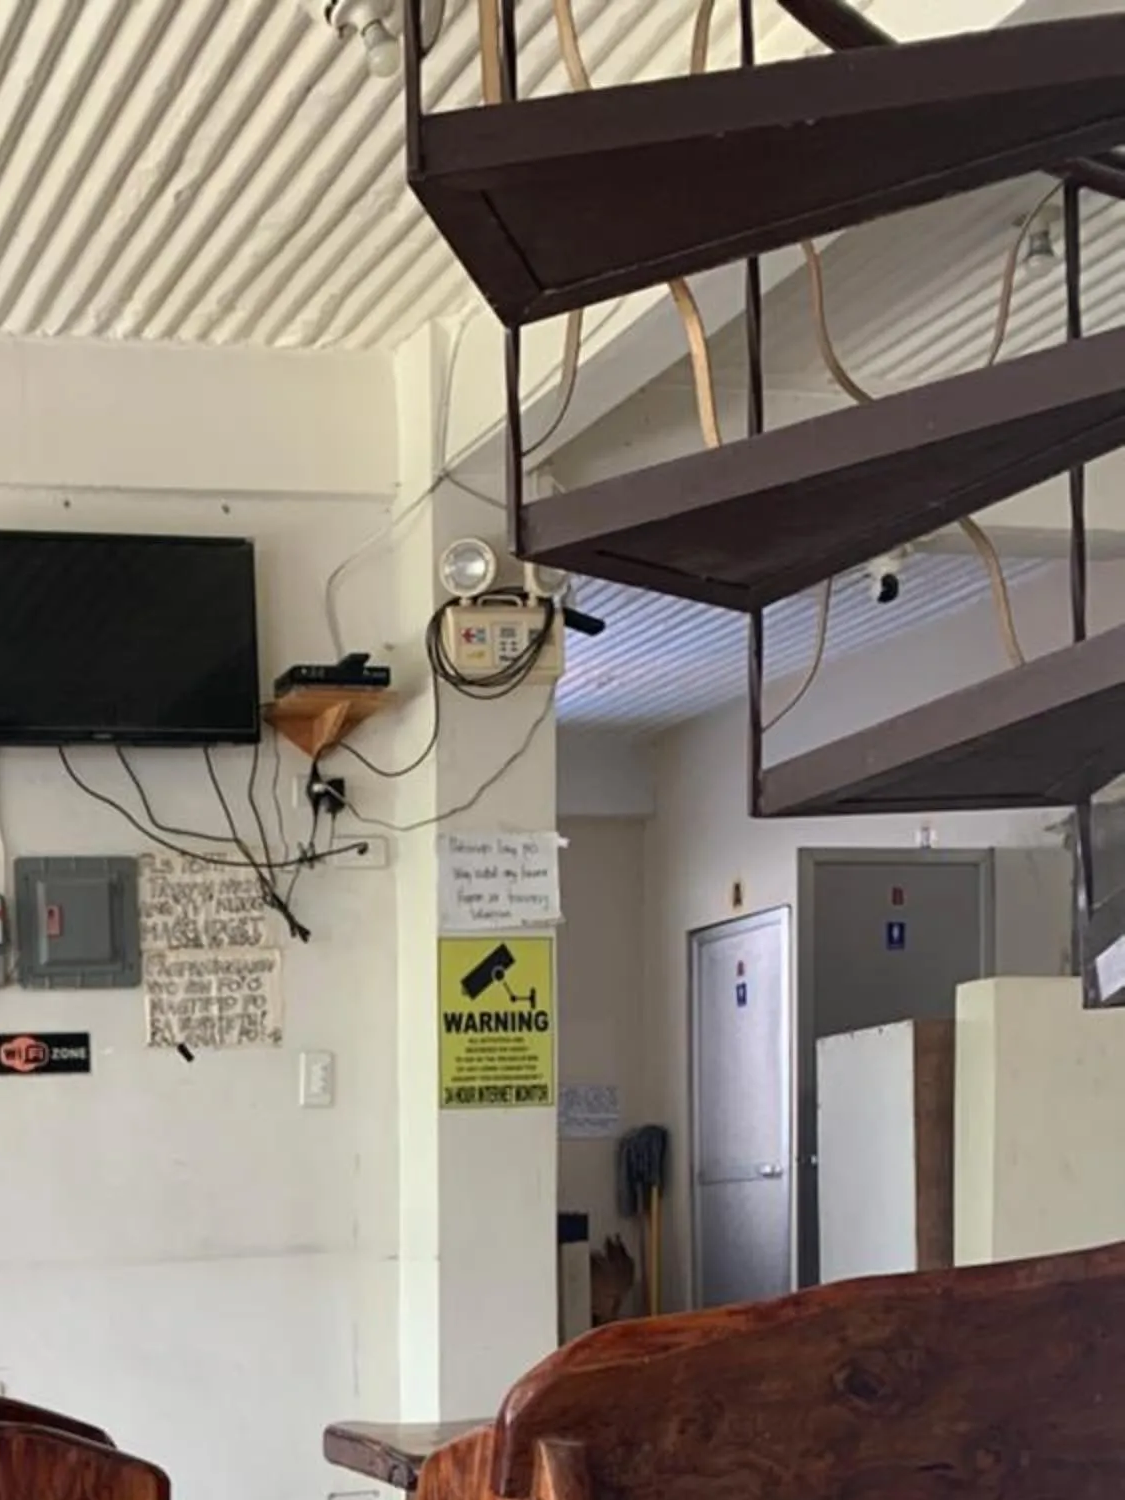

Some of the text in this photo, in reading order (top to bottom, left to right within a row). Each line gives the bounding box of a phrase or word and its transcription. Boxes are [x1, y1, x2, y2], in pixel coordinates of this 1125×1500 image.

[732, 881, 743, 907] A
[442, 1010, 549, 1034] WARNING
[51, 1046, 87, 1061] ZONE
